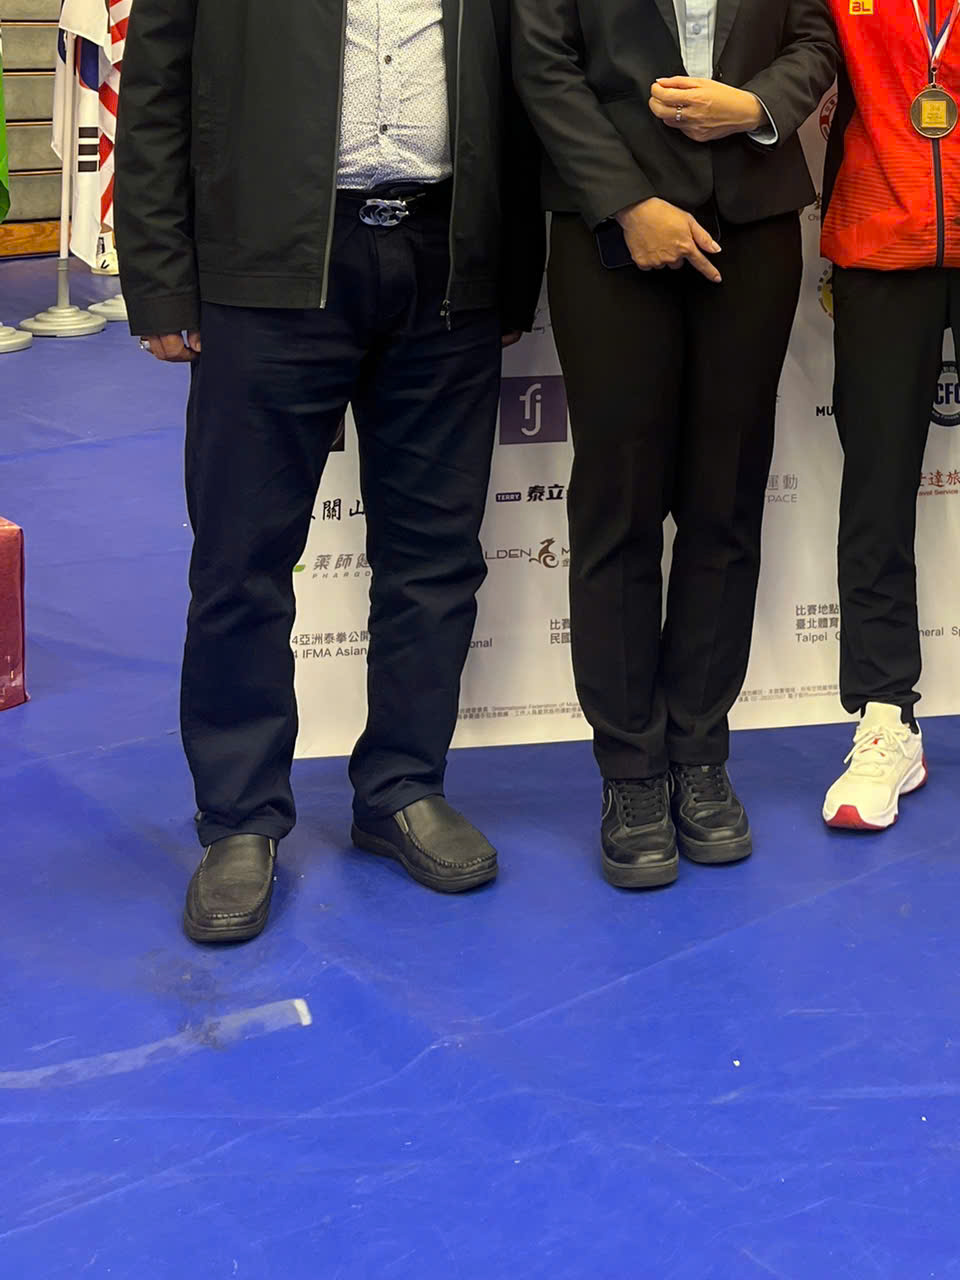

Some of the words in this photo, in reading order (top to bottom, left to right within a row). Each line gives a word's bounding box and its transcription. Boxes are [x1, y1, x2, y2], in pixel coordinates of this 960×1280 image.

[311, 497, 366, 521] 關山
[795, 631, 828, 644] Taipei
[302, 648, 332, 659] IFMA
[335, 646, 367, 657] Asian
